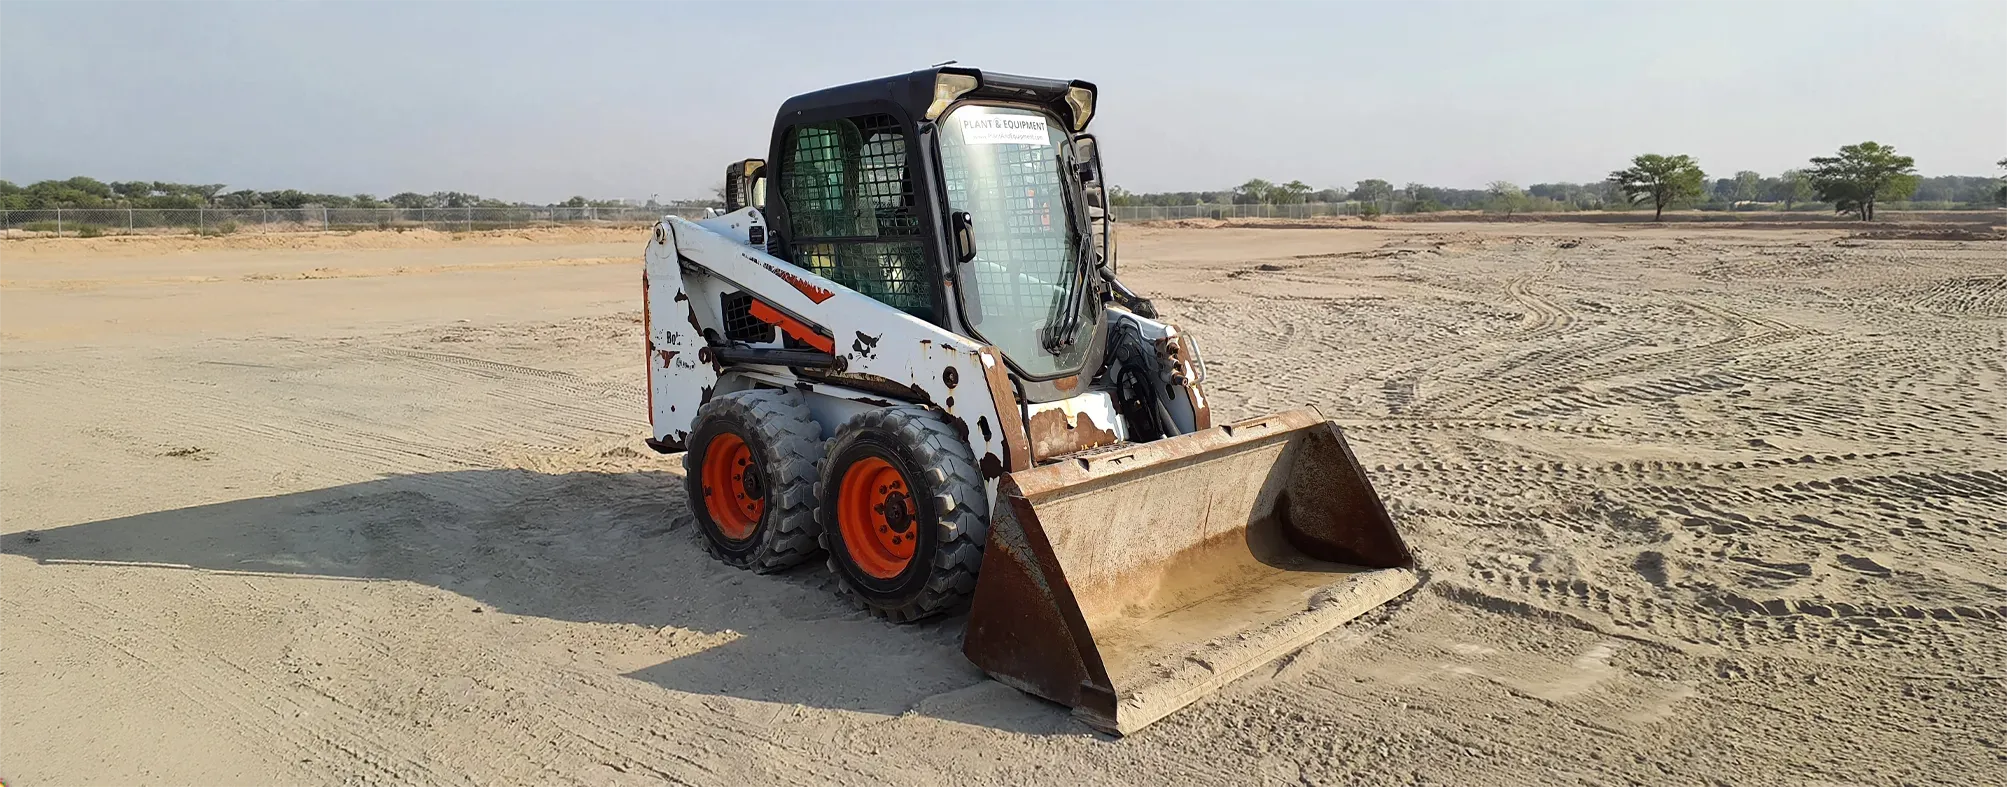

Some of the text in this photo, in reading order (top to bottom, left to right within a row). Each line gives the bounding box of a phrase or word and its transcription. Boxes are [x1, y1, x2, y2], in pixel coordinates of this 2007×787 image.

[964, 120, 1045, 131] PLANT & EQUIPMENT
